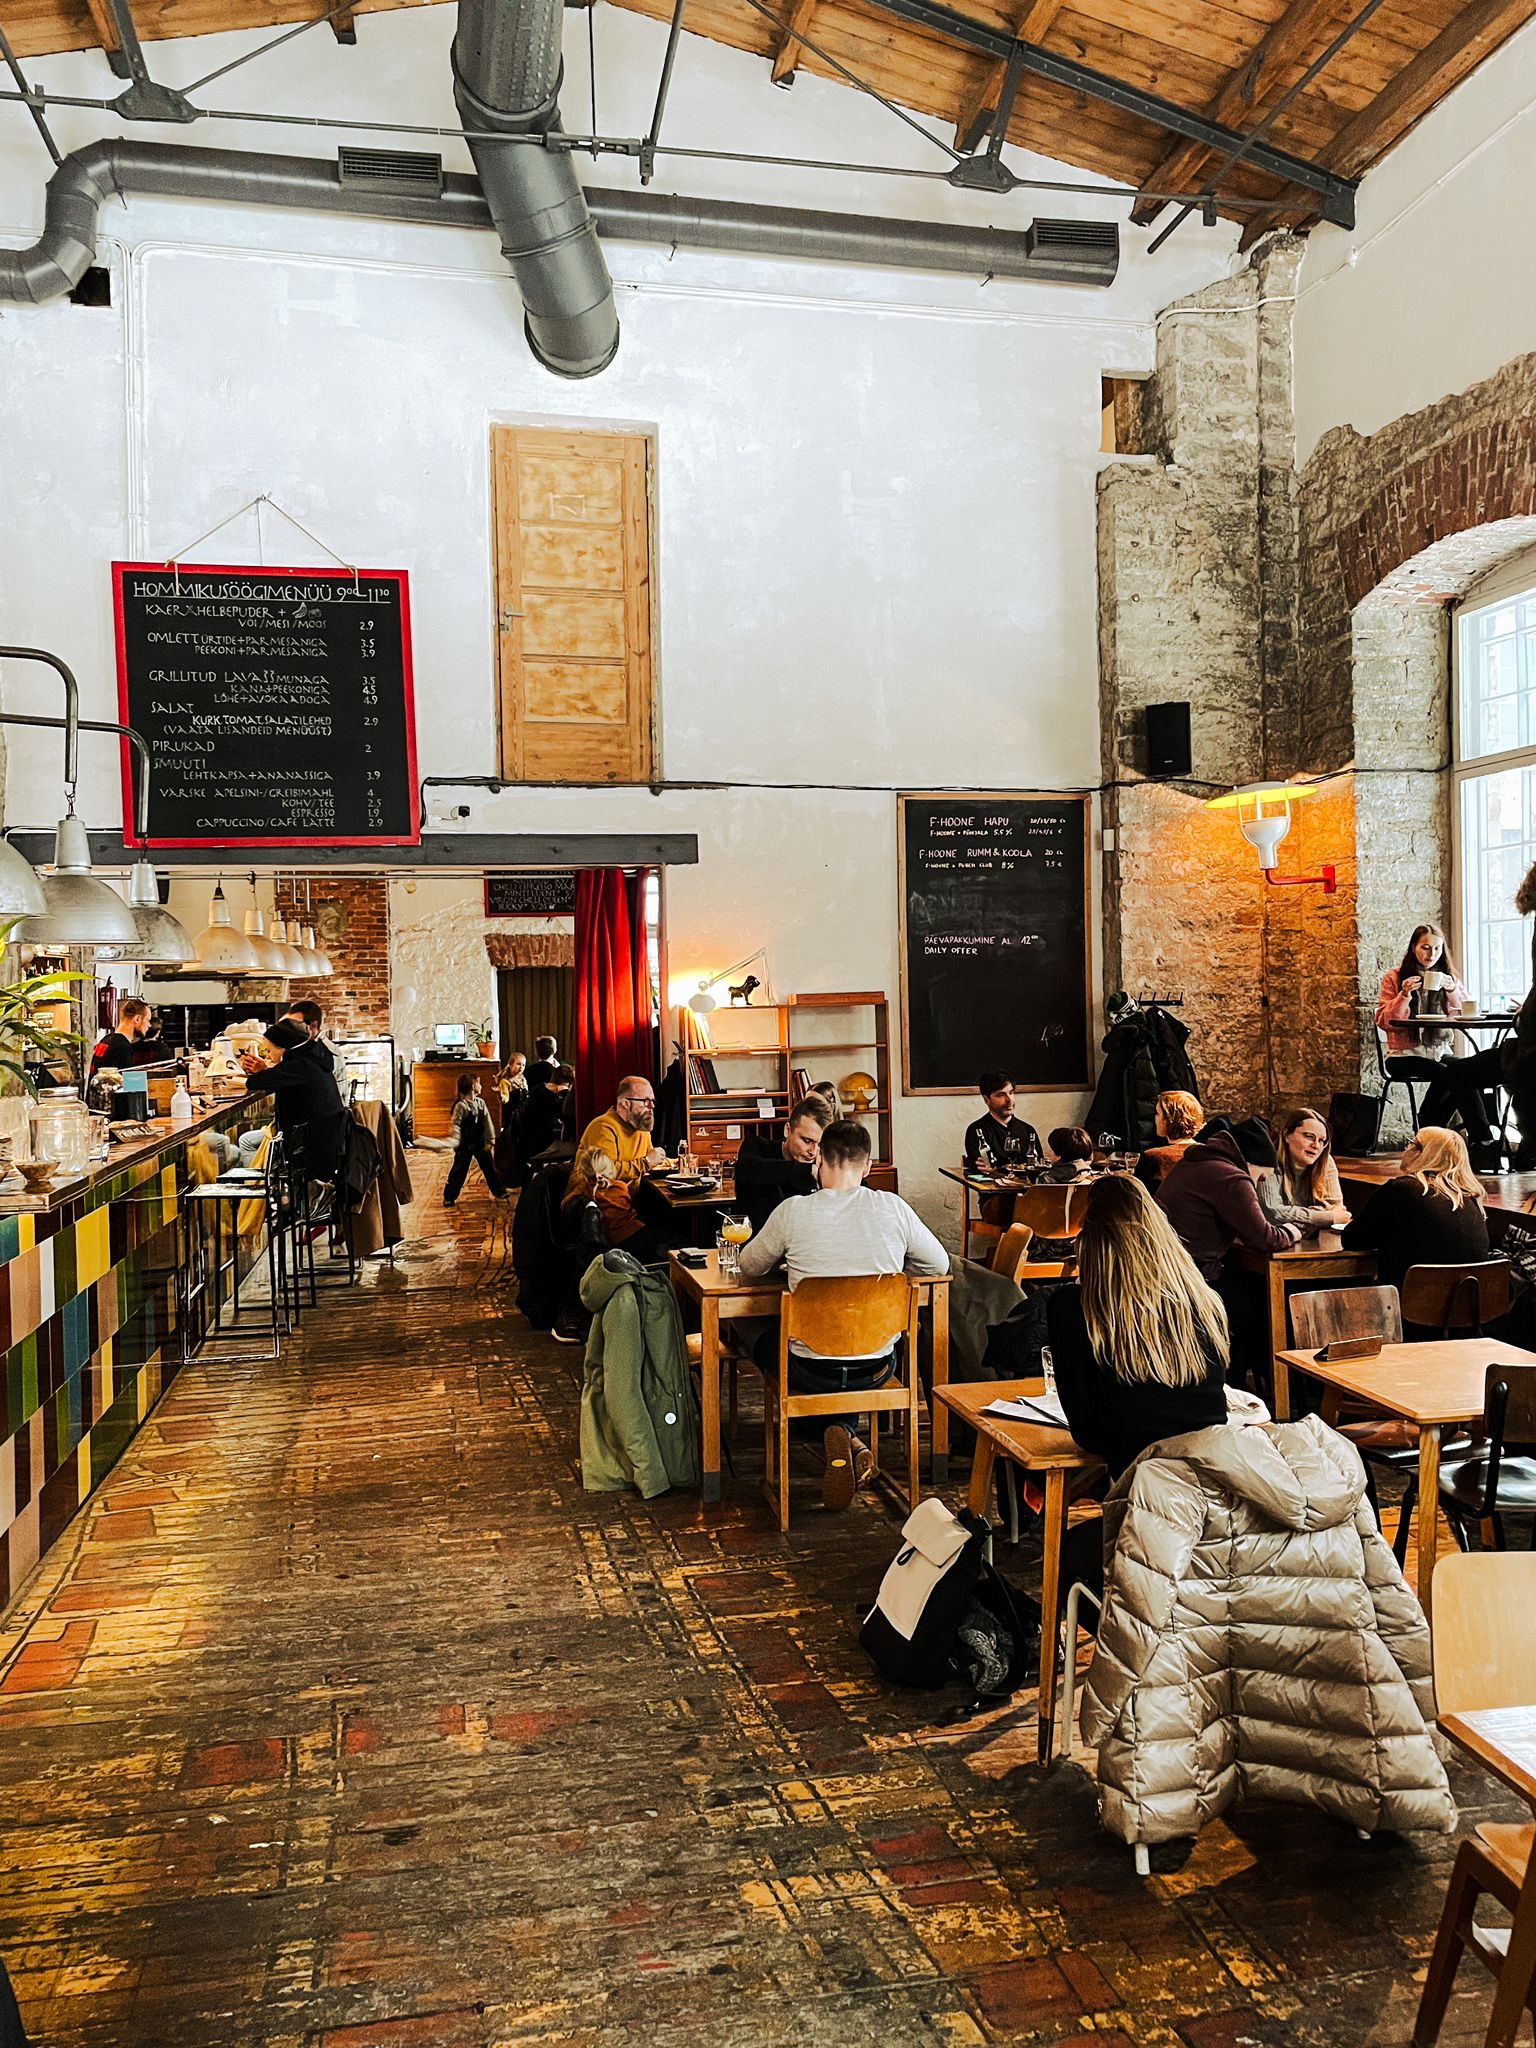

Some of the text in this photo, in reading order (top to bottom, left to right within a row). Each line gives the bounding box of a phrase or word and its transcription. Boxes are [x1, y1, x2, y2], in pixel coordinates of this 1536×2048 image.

[360, 621, 374, 631] 2.9
[147, 632, 199, 644] OMLETT
[361, 638, 375, 649] 3.5
[361, 650, 376, 658] 3.9
[149, 670, 217, 682] GRILLITUD
[362, 676, 376, 686] 3.5
[363, 695, 378, 705] 4.9
[151, 701, 194, 714] SALAT
[363, 717, 379, 726] 2.9
[163, 725, 214, 735] (VAATA
[218, 726, 273, 735] LISANDEID
[152, 741, 372, 753] PIRUKAD 2
[153, 757, 206, 770] SMUUTI
[367, 771, 381, 781] 3.9
[367, 799, 382, 808] 2.5
[291, 808, 380, 818] ESPRESSO 1.9
[303, 818, 335, 827] LATTE
[368, 818, 384, 827] 2.9
[984, 816, 1009, 826] HAPU
[967, 848, 992, 857] RUMM
[992, 847, 1000, 857] &
[1002, 848, 1033, 858] KOOLA
[924, 946, 978, 955] DAILY OFFER
